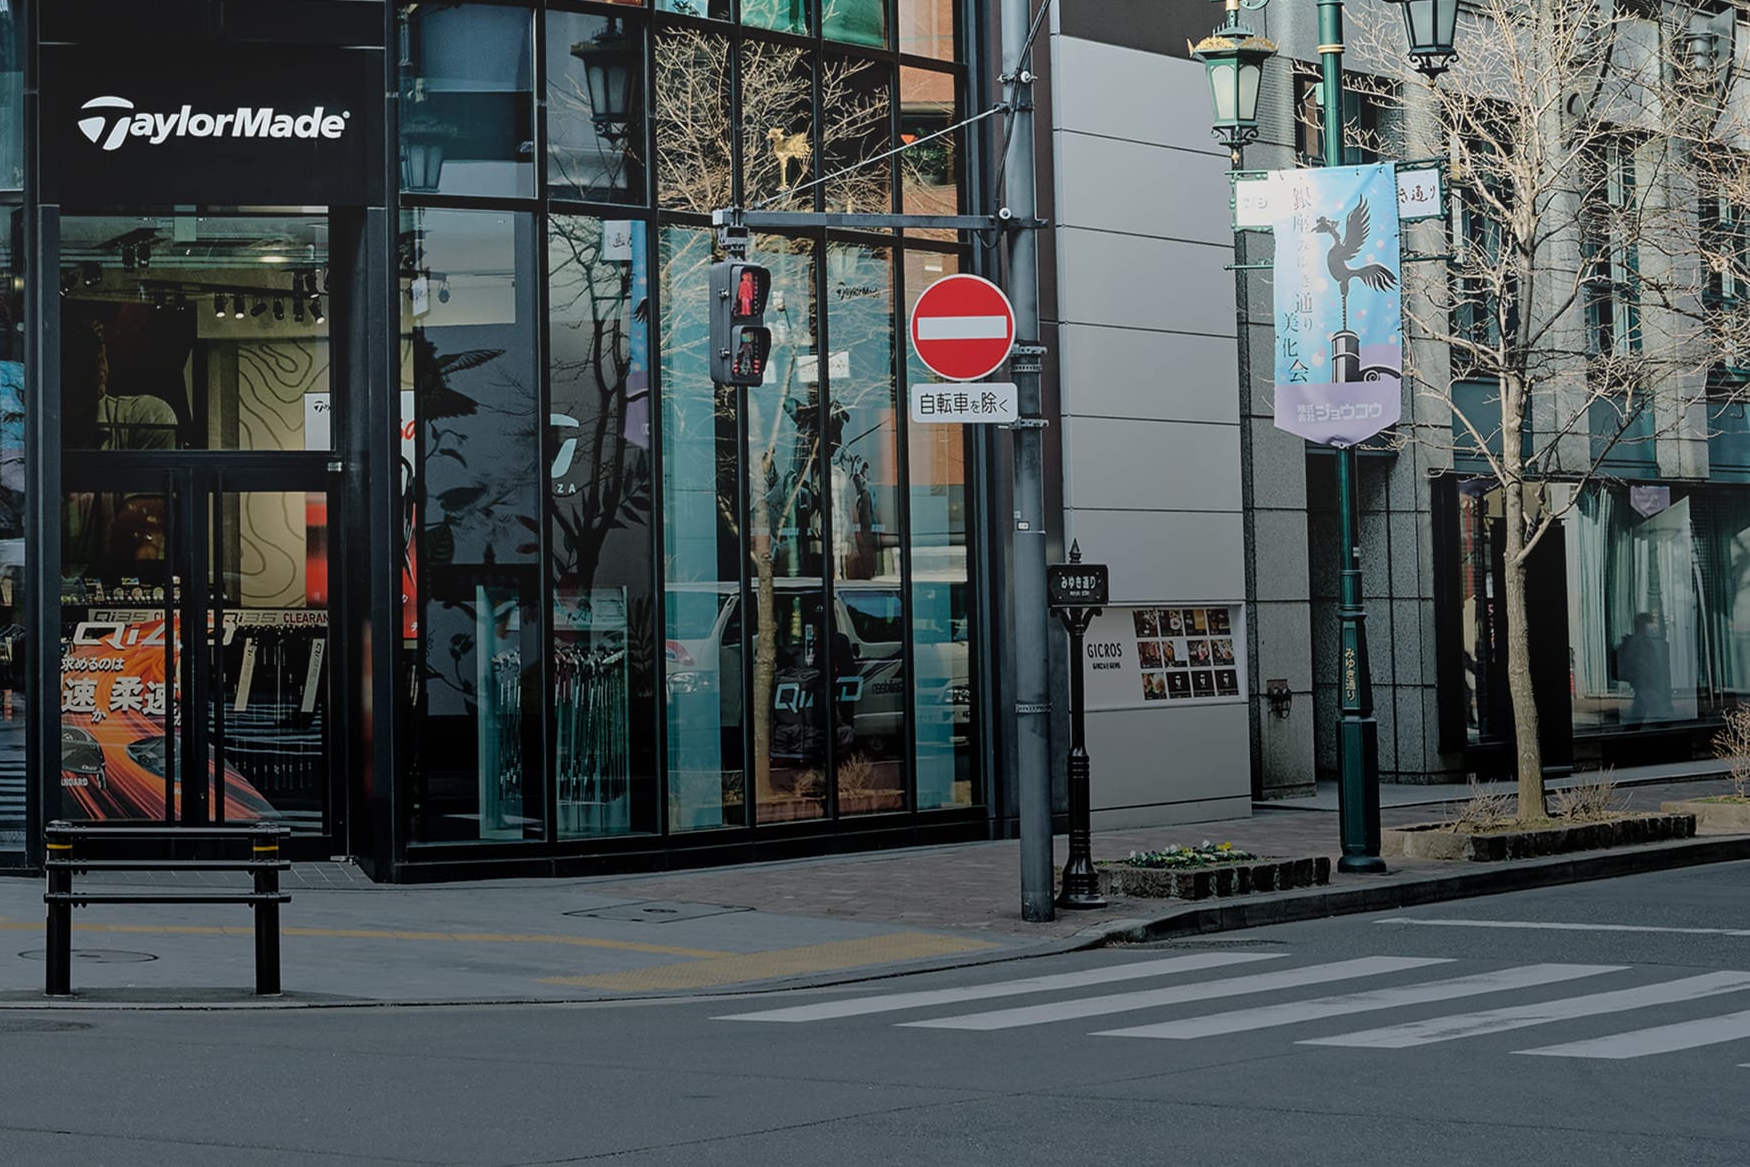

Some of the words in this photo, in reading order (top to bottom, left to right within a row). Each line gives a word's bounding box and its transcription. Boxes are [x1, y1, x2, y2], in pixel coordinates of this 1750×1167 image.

[77, 95, 351, 151] TaylorMade
[1399, 187, 1436, 203] き通り
[1282, 312, 1309, 383] 美化会
[920, 392, 1009, 415] 自転車を除く
[283, 612, 329, 625] CLEARAN
[1086, 642, 1123, 659] GICROS
